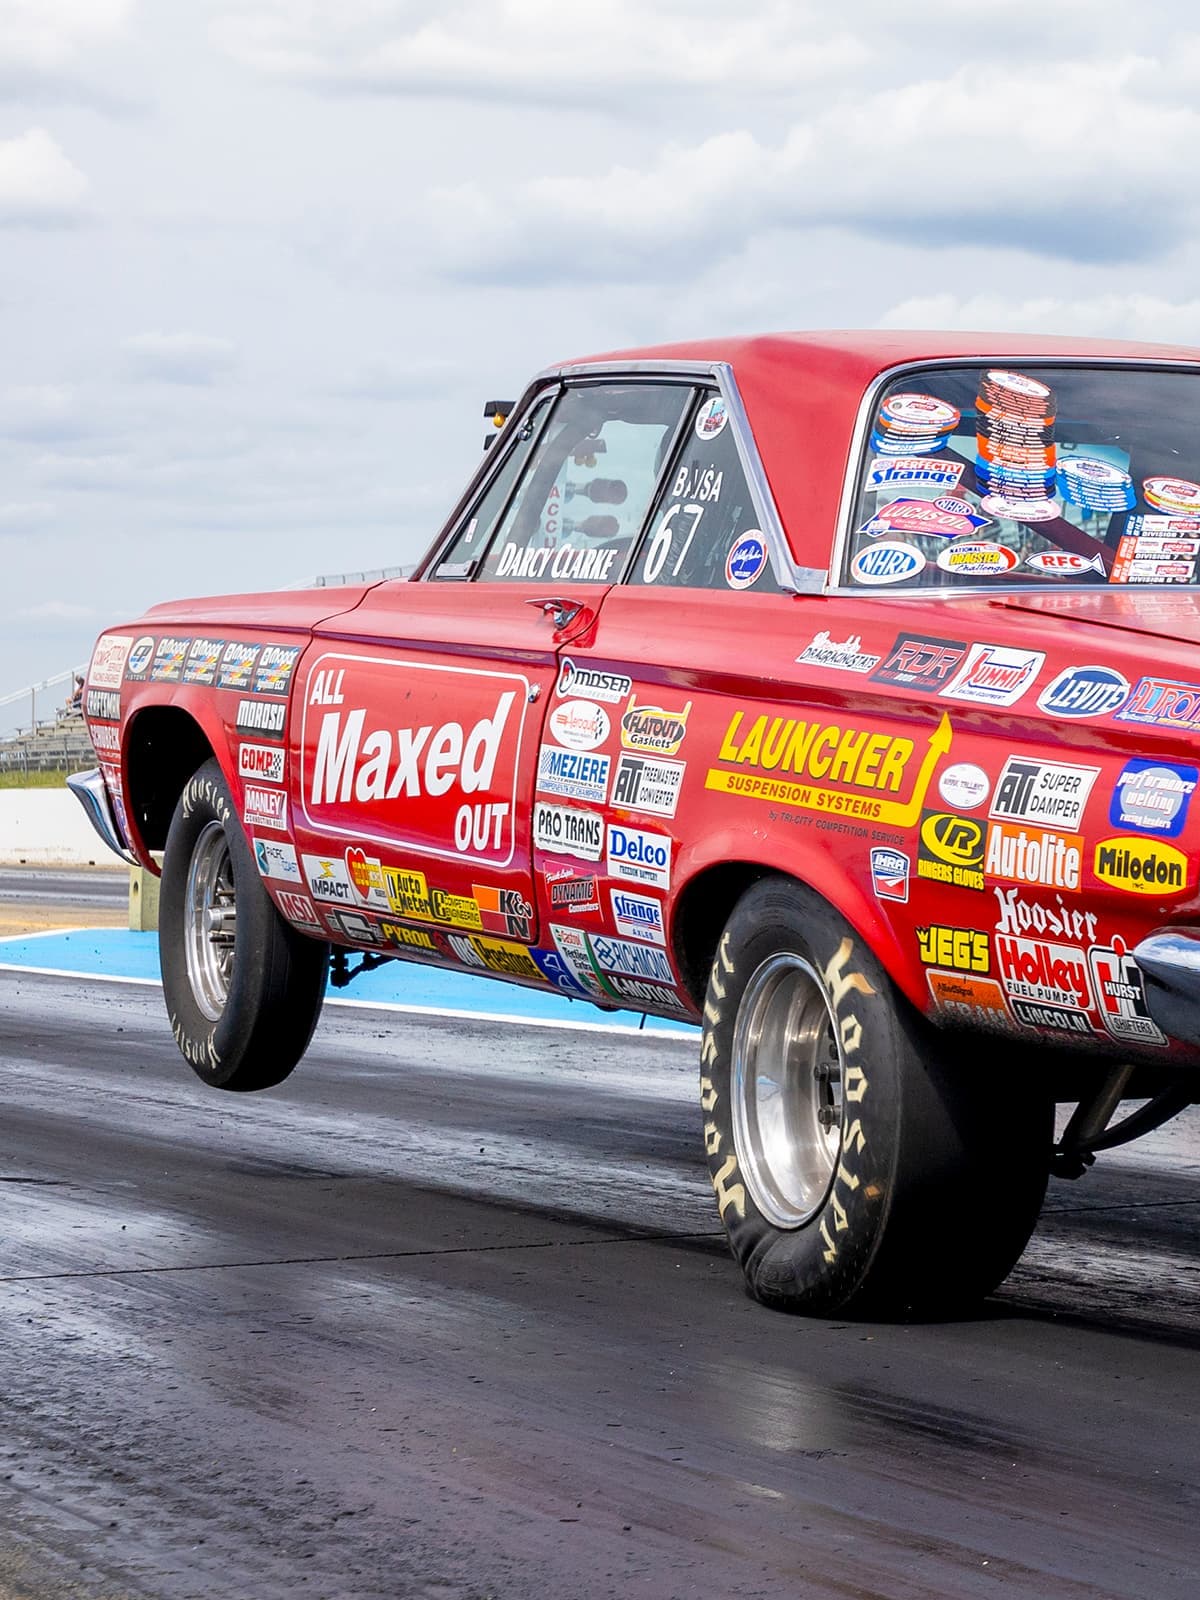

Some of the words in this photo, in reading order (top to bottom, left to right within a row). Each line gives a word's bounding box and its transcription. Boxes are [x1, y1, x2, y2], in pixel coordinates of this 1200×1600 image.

[872, 467, 957, 485] Strange
[895, 459, 961, 473] PERFECTLY
[882, 505, 941, 523] LUCAS
[940, 515, 970, 530] OIL
[937, 499, 970, 514] NHRA
[643, 503, 704, 584] 67
[496, 542, 551, 578] DARCY
[551, 543, 618, 580] CLARKE
[862, 549, 913, 576] NHRA
[949, 553, 1000, 566] DRAGSTER
[1041, 555, 1083, 568] RFC
[162, 638, 191, 657] Mopar
[199, 640, 225, 659] Mopar
[231, 643, 260, 663] Mopar
[267, 647, 299, 667] Mopar
[884, 641, 965, 678] RDR
[575, 671, 630, 693] MOSER
[953, 649, 1036, 693] SUMMIT
[310, 669, 345, 705] ALL
[1049, 677, 1130, 711] CLEVITE
[237, 700, 286, 731] MOROSO
[629, 715, 679, 739] FLATOUT
[311, 691, 517, 805] Maxed
[630, 734, 672, 749] Gaskets
[718, 711, 914, 792] LAUNCHER
[242, 748, 273, 771] COMP
[550, 752, 609, 784] MEZIERE
[263, 770, 279, 778] CAMS
[614, 759, 645, 803] ATI
[1040, 772, 1081, 794] SUPER
[1117, 772, 1196, 793] performance
[640, 787, 674, 807] CONVERTER
[726, 775, 811, 803] SUSPENSION
[816, 793, 882, 818] SYSTEMS
[995, 763, 1041, 815] ATI
[246, 789, 281, 819] MANLEY
[1030, 795, 1080, 818] DAMPER
[1125, 791, 1174, 815] welding
[454, 802, 510, 851] OUT
[538, 809, 561, 835] PRO
[564, 815, 600, 846] TRANS
[768, 811, 778, 822] by
[780, 812, 813, 826] TRI-CITY
[816, 819, 868, 837] COMPETITION
[871, 831, 904, 845] SERVICE
[610, 829, 666, 866] Delco
[986, 824, 1080, 889] Autolite
[918, 859, 952, 883] RINGERS
[953, 866, 984, 890] GLOVES
[1099, 847, 1182, 886] Milodon
[311, 879, 349, 899] IMPACT
[397, 873, 421, 895] Auto
[552, 881, 594, 903] DYNAMIC
[280, 893, 313, 923] MSD
[399, 893, 431, 914] Meter
[614, 896, 660, 923] Strange
[994, 886, 1098, 943] Hoosier
[382, 923, 437, 949] PYROIL
[632, 928, 654, 940] AXLES
[920, 924, 990, 972] JEG'S
[614, 943, 673, 982] RICHMOND
[998, 937, 1088, 1008] Holley
[610, 976, 684, 1007] K-MOTION
[1007, 982, 1034, 998] FUEL
[1038, 988, 1077, 1006] PUMPS
[1105, 981, 1141, 1000] HURST
[1017, 1003, 1090, 1034] LINCOLN
[1114, 1018, 1153, 1036] SHIFTERS
